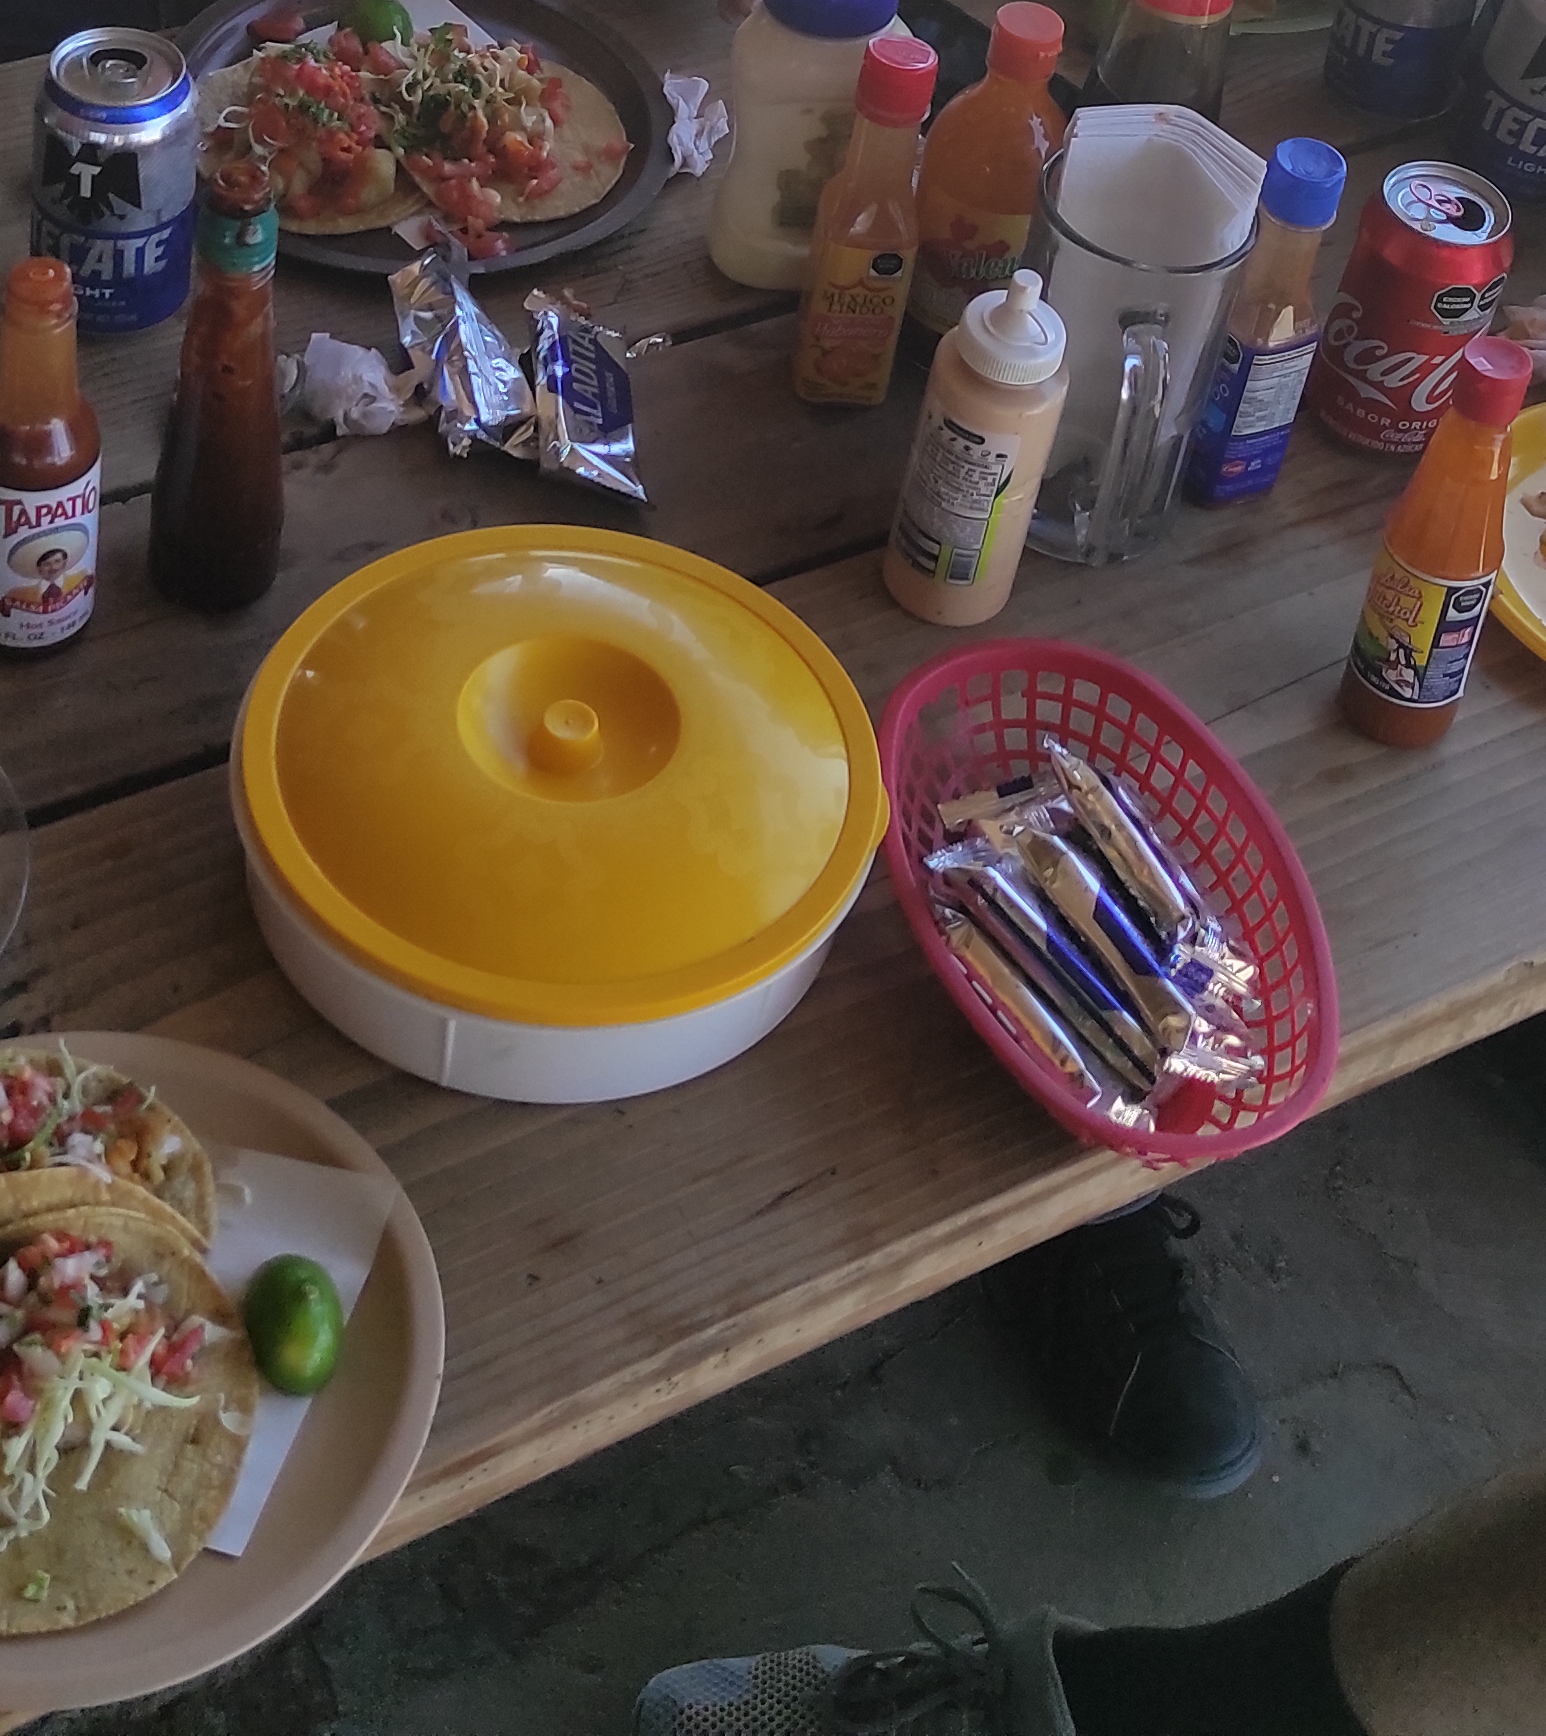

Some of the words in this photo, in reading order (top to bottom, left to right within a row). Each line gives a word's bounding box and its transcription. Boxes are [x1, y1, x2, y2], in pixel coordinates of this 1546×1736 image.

[72, 283, 115, 300] GHT
[1337, 395, 1391, 428] SABOR
[1398, 418, 1439, 430] ORIG
